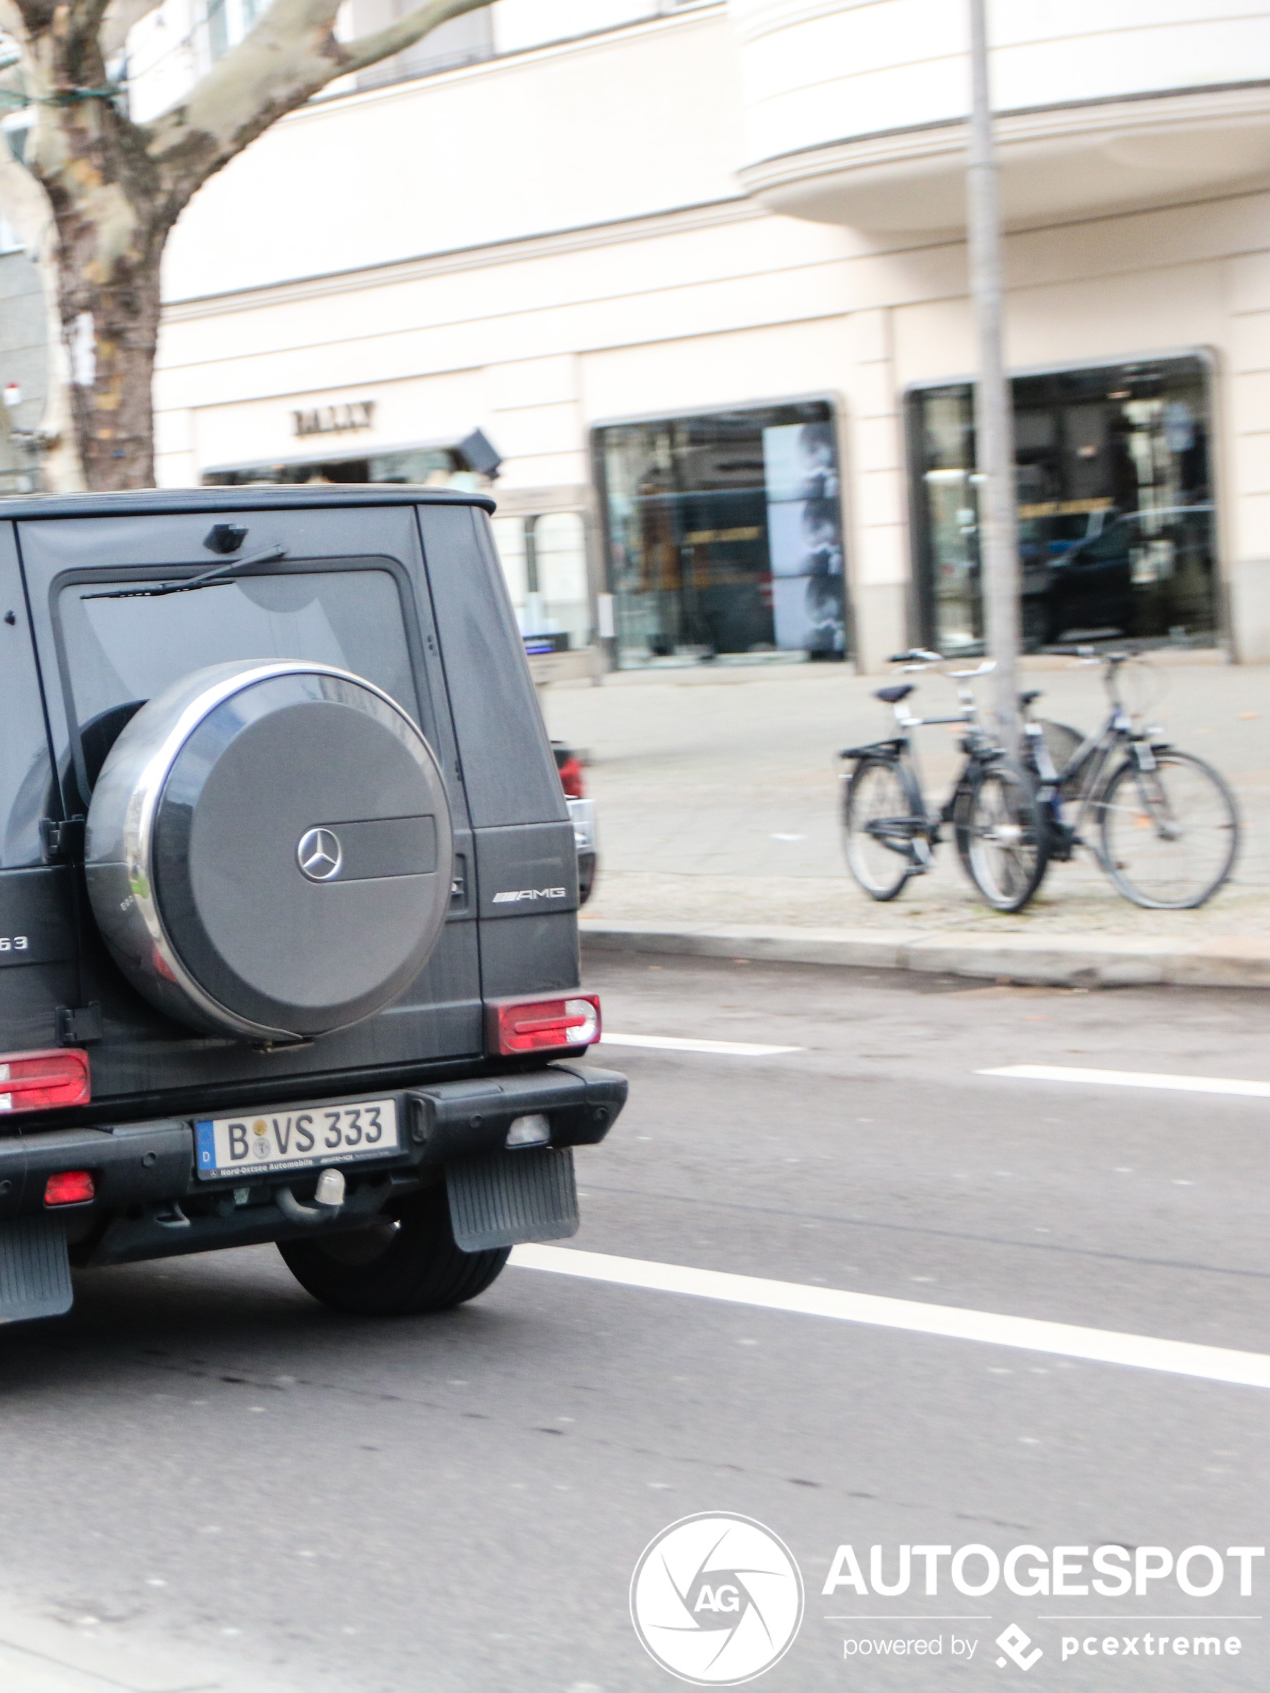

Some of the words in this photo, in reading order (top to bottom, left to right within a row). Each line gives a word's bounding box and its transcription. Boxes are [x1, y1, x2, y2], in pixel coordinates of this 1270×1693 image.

[515, 887, 566, 901] AMG
[228, 1123, 250, 1160] B
[273, 1114, 315, 1155] VS
[324, 1106, 382, 1148] 333
[202, 1151, 210, 1163] D
[220, 1164, 267, 1176] Nord-Ostsee
[269, 1159, 313, 1171] Automobile
